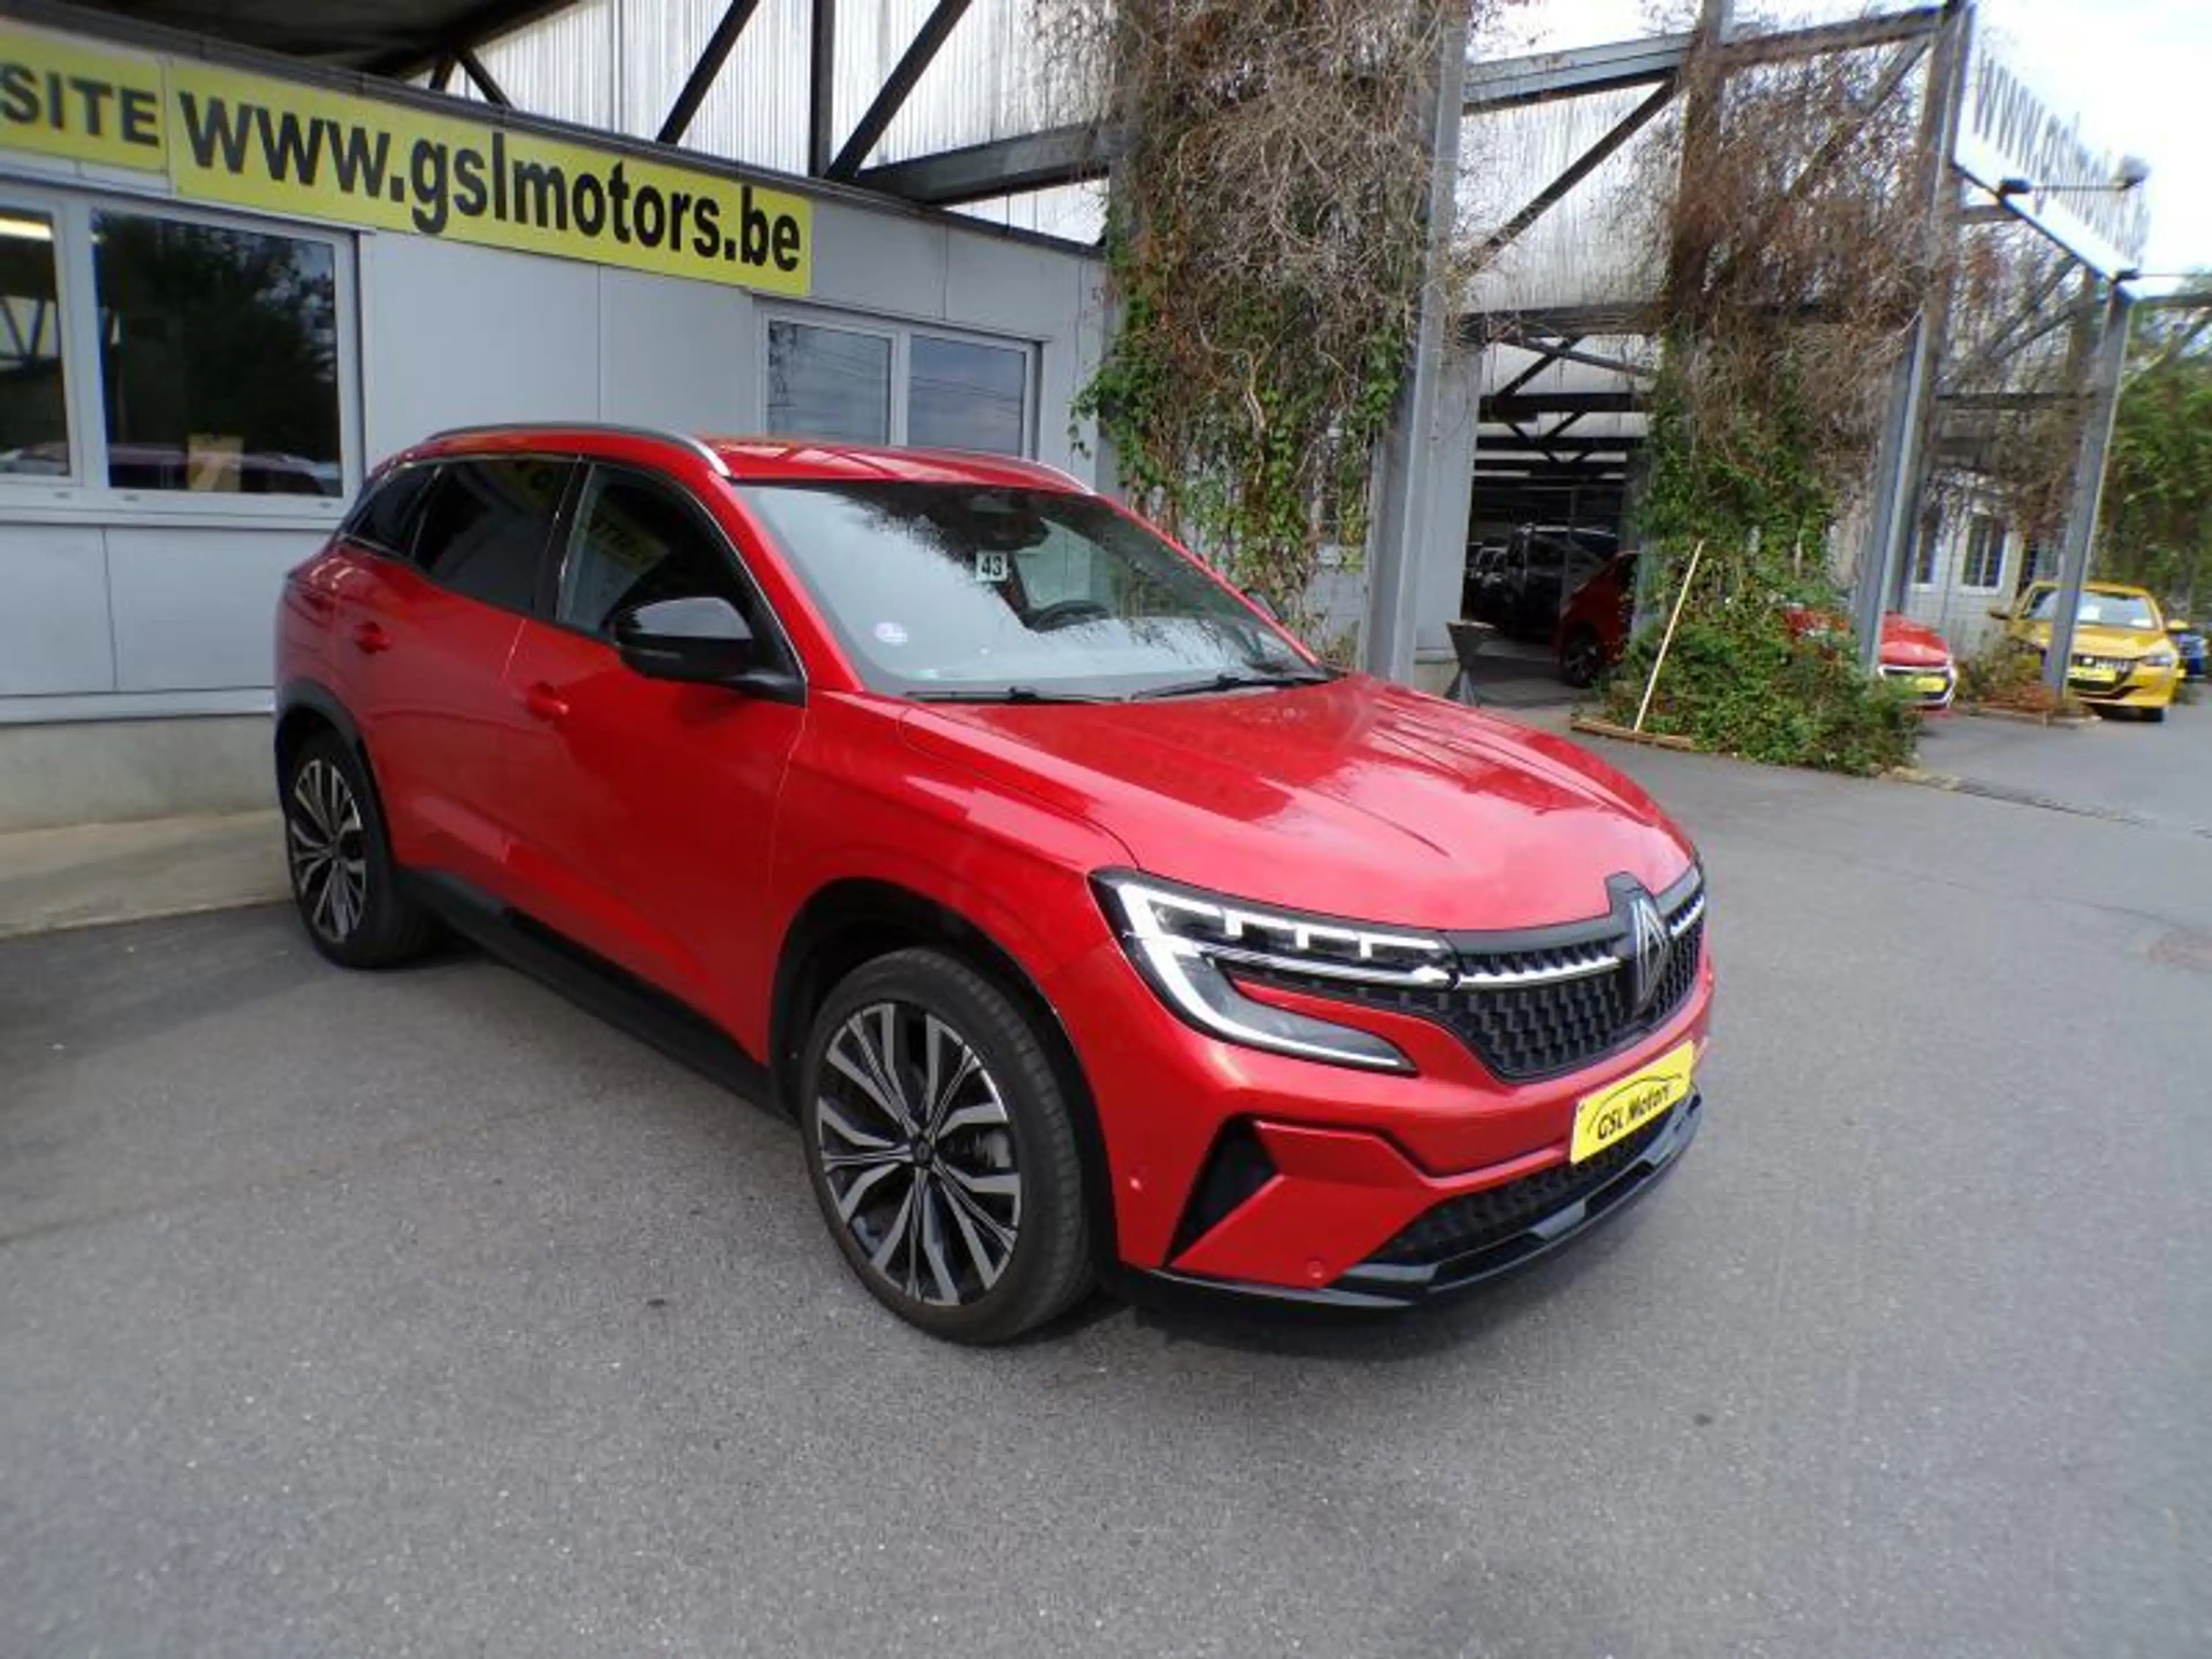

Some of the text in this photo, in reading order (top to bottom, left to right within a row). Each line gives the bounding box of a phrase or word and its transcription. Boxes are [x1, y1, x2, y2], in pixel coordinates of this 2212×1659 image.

[0, 62, 160, 148] SITE
[981, 555, 1002, 575] 43
[1597, 1107, 1624, 1139] GSL
